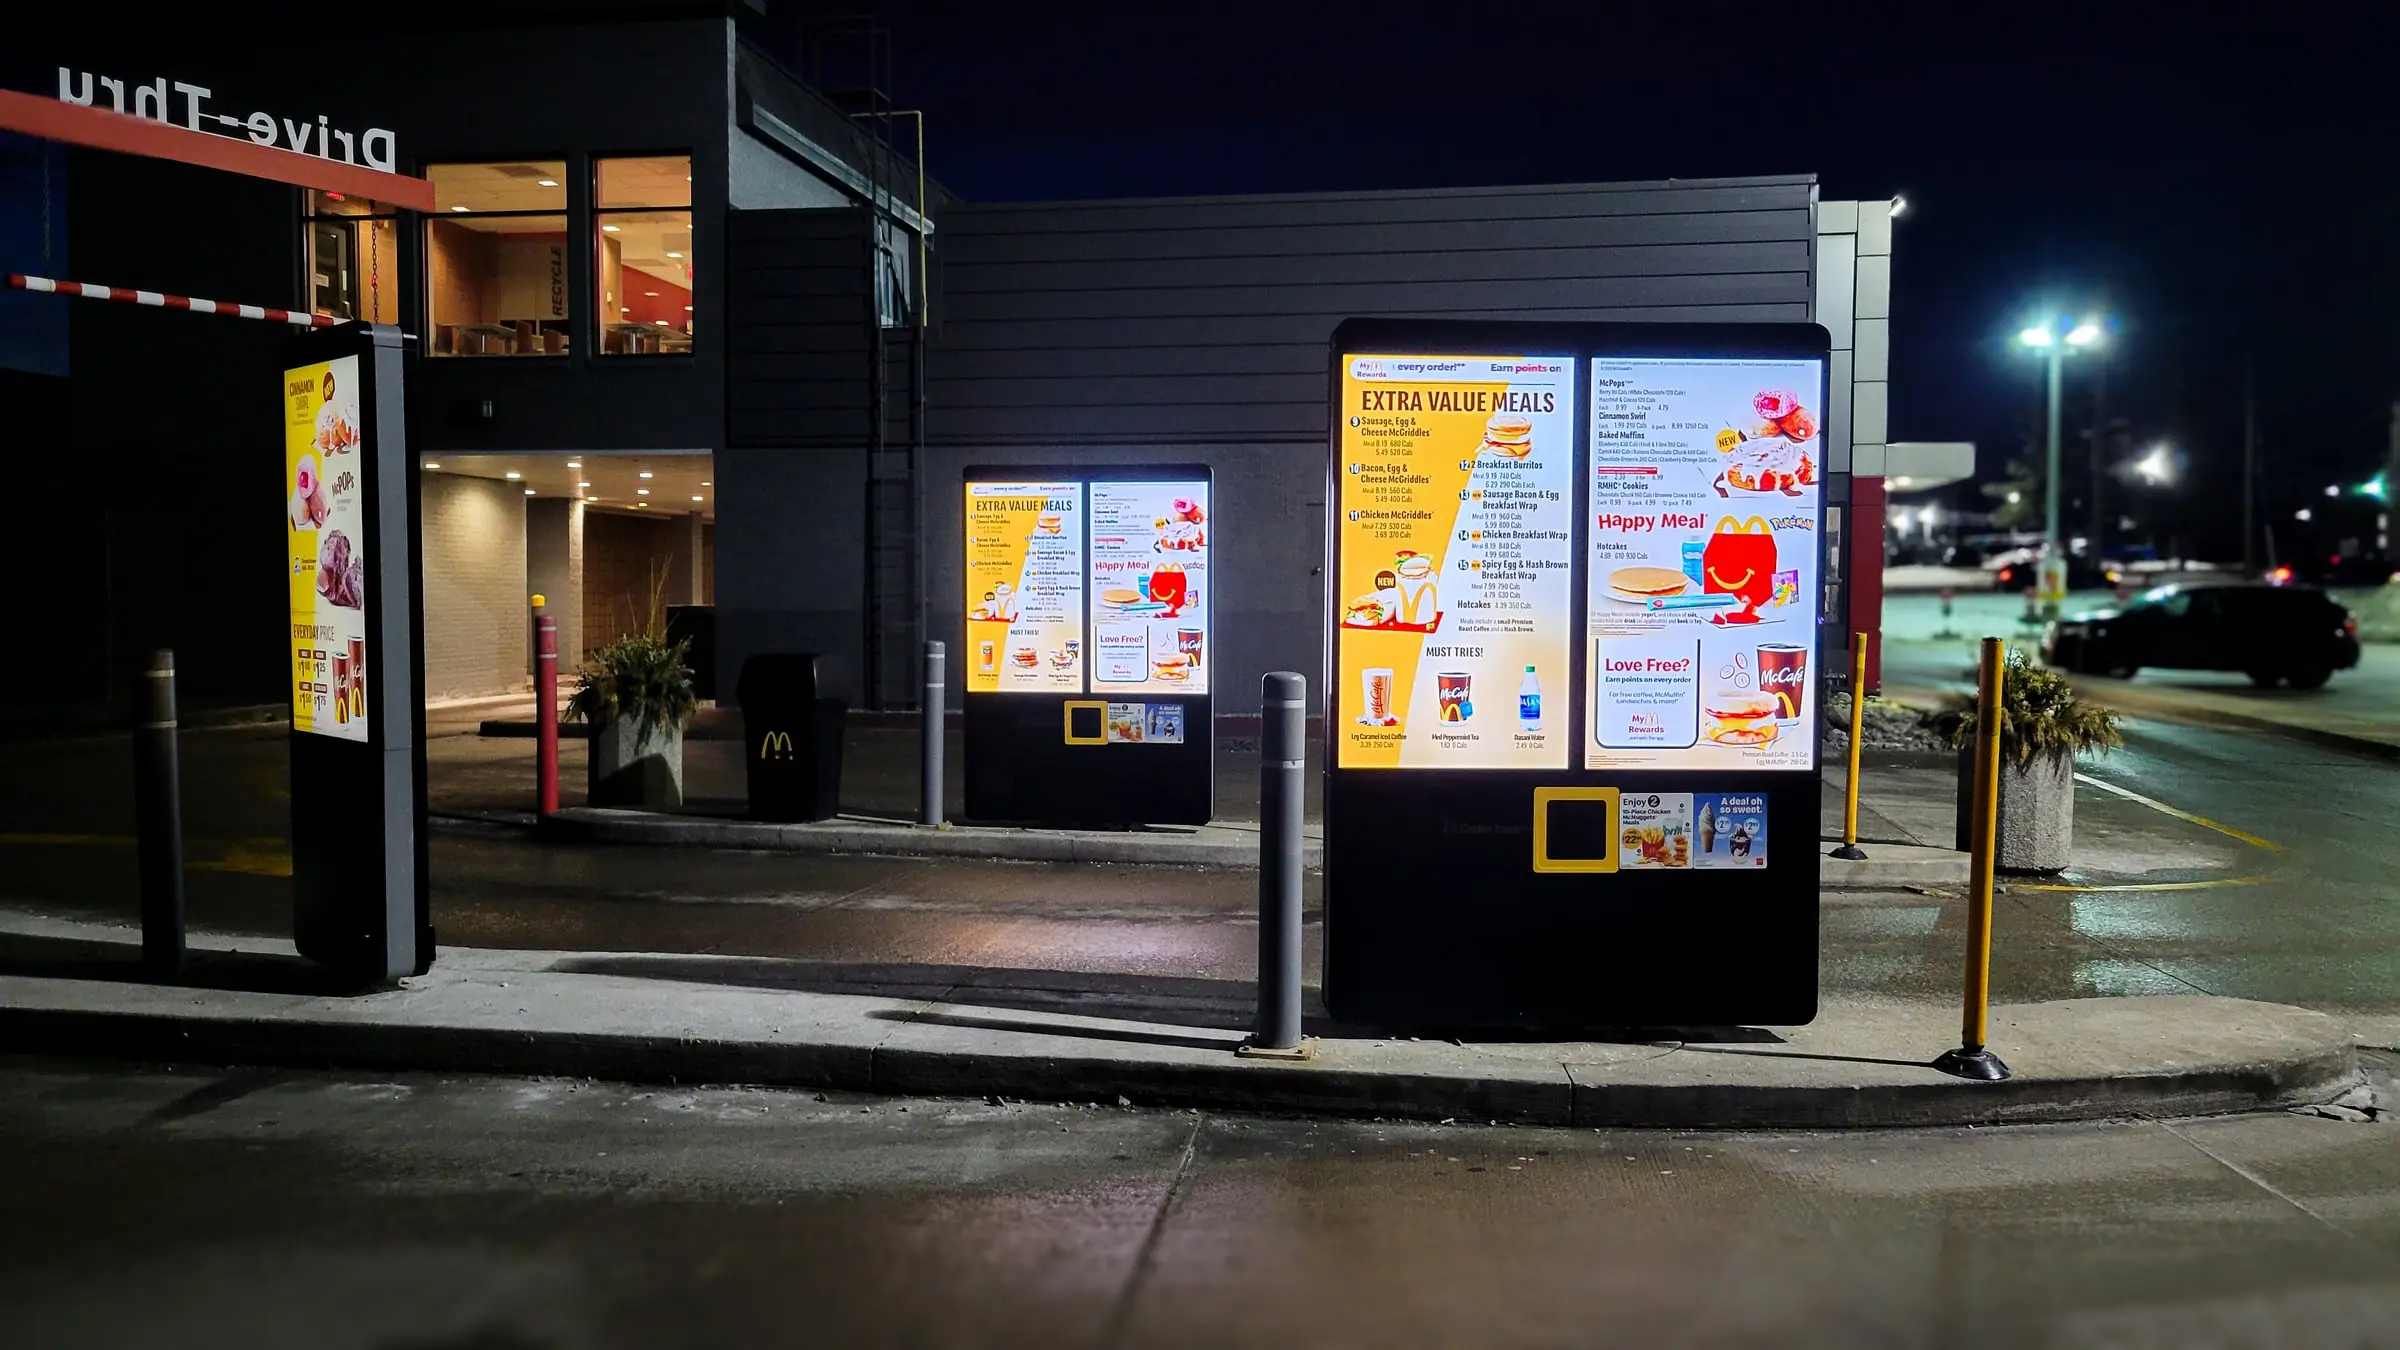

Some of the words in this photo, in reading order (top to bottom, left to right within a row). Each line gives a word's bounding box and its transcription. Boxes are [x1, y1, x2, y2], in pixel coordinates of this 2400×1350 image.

[549, 245, 563, 316] RECYCLE
[1397, 363, 1425, 373] every
[1491, 363, 1513, 372] Earn
[1515, 363, 1547, 374] points
[290, 379, 315, 397] CINNAMON
[1599, 379, 1625, 388] McPops
[1362, 390, 1423, 411] EXTRA
[1428, 391, 1487, 412] VALUE
[1492, 391, 1555, 413] MEALS
[1599, 412, 1630, 420] Cinnamon
[1630, 412, 1646, 420] Swirl
[1361, 416, 1394, 427] Sausage,
[1395, 416, 1409, 428] Egg
[1410, 416, 1416, 426] &
[1361, 428, 1387, 437] Cheese
[1598, 431, 1619, 440] Baked
[1620, 432, 1645, 440] Muffins
[1718, 435, 1737, 448] NEW
[1361, 463, 1386, 473] Bacon,
[1387, 463, 1401, 474] Egg
[1402, 463, 1408, 472] &
[1471, 460, 1476, 469] 2
[1477, 460, 1512, 469] Breakfast
[1513, 461, 1543, 470] Burritos
[1360, 475, 1387, 483] Cheese
[1597, 482, 1618, 490] RMHC
[1622, 482, 1649, 490] Cookies
[1482, 489, 1513, 501] Sausage
[1514, 490, 1537, 499] Bacon
[1538, 490, 1544, 499] &
[1545, 490, 1560, 501] Egg
[976, 500, 1007, 511] EXTRA
[1009, 500, 1039, 511] VALUE
[1041, 500, 1073, 511] MEALS
[1482, 501, 1518, 510] Breakfast
[1519, 502, 1538, 512] Wrap
[1360, 510, 1390, 519] Chicken
[1598, 513, 1656, 533] Happy
[1661, 513, 1705, 529] Meal
[1482, 529, 1511, 539] Chicken
[1512, 530, 1548, 540] Breakfast
[1549, 531, 1568, 542] Wrap
[1597, 542, 1628, 551] Hotcakes
[1095, 562, 1125, 571] Happy
[1127, 561, 1150, 570] Meal
[1481, 560, 1502, 570] Spicy
[1503, 560, 1517, 571] Egg
[1518, 560, 1524, 569] &
[1525, 560, 1544, 569] Hash
[1545, 560, 1569, 569] Brown
[1481, 571, 1517, 580] Breakfast
[1518, 571, 1537, 581] Wrap
[1377, 577, 1395, 587] NEW
[1457, 600, 1491, 609] Hotcakes
[293, 624, 319, 640] EVERYDAY
[319, 625, 335, 642] PRICE
[1100, 635, 1120, 643] Love
[1121, 635, 1144, 643] Free?
[1426, 646, 1451, 658] MUST
[1453, 646, 1484, 658] TRIES!
[1605, 658, 1643, 672] Love
[1646, 658, 1690, 672] Free?
[1621, 676, 1643, 684] points
[1654, 677, 1672, 685] every
[1760, 666, 1804, 687] McCafé
[1633, 691, 1653, 699] coffee,
[1632, 715, 1645, 724] My
[1628, 725, 1665, 734] Rewards
[1623, 797, 1647, 808] Enjoy
[1721, 797, 1728, 806] A
[1729, 796, 1749, 805] deal
[1751, 796, 1763, 805] oh
[1732, 806, 1763, 814] sweet.
